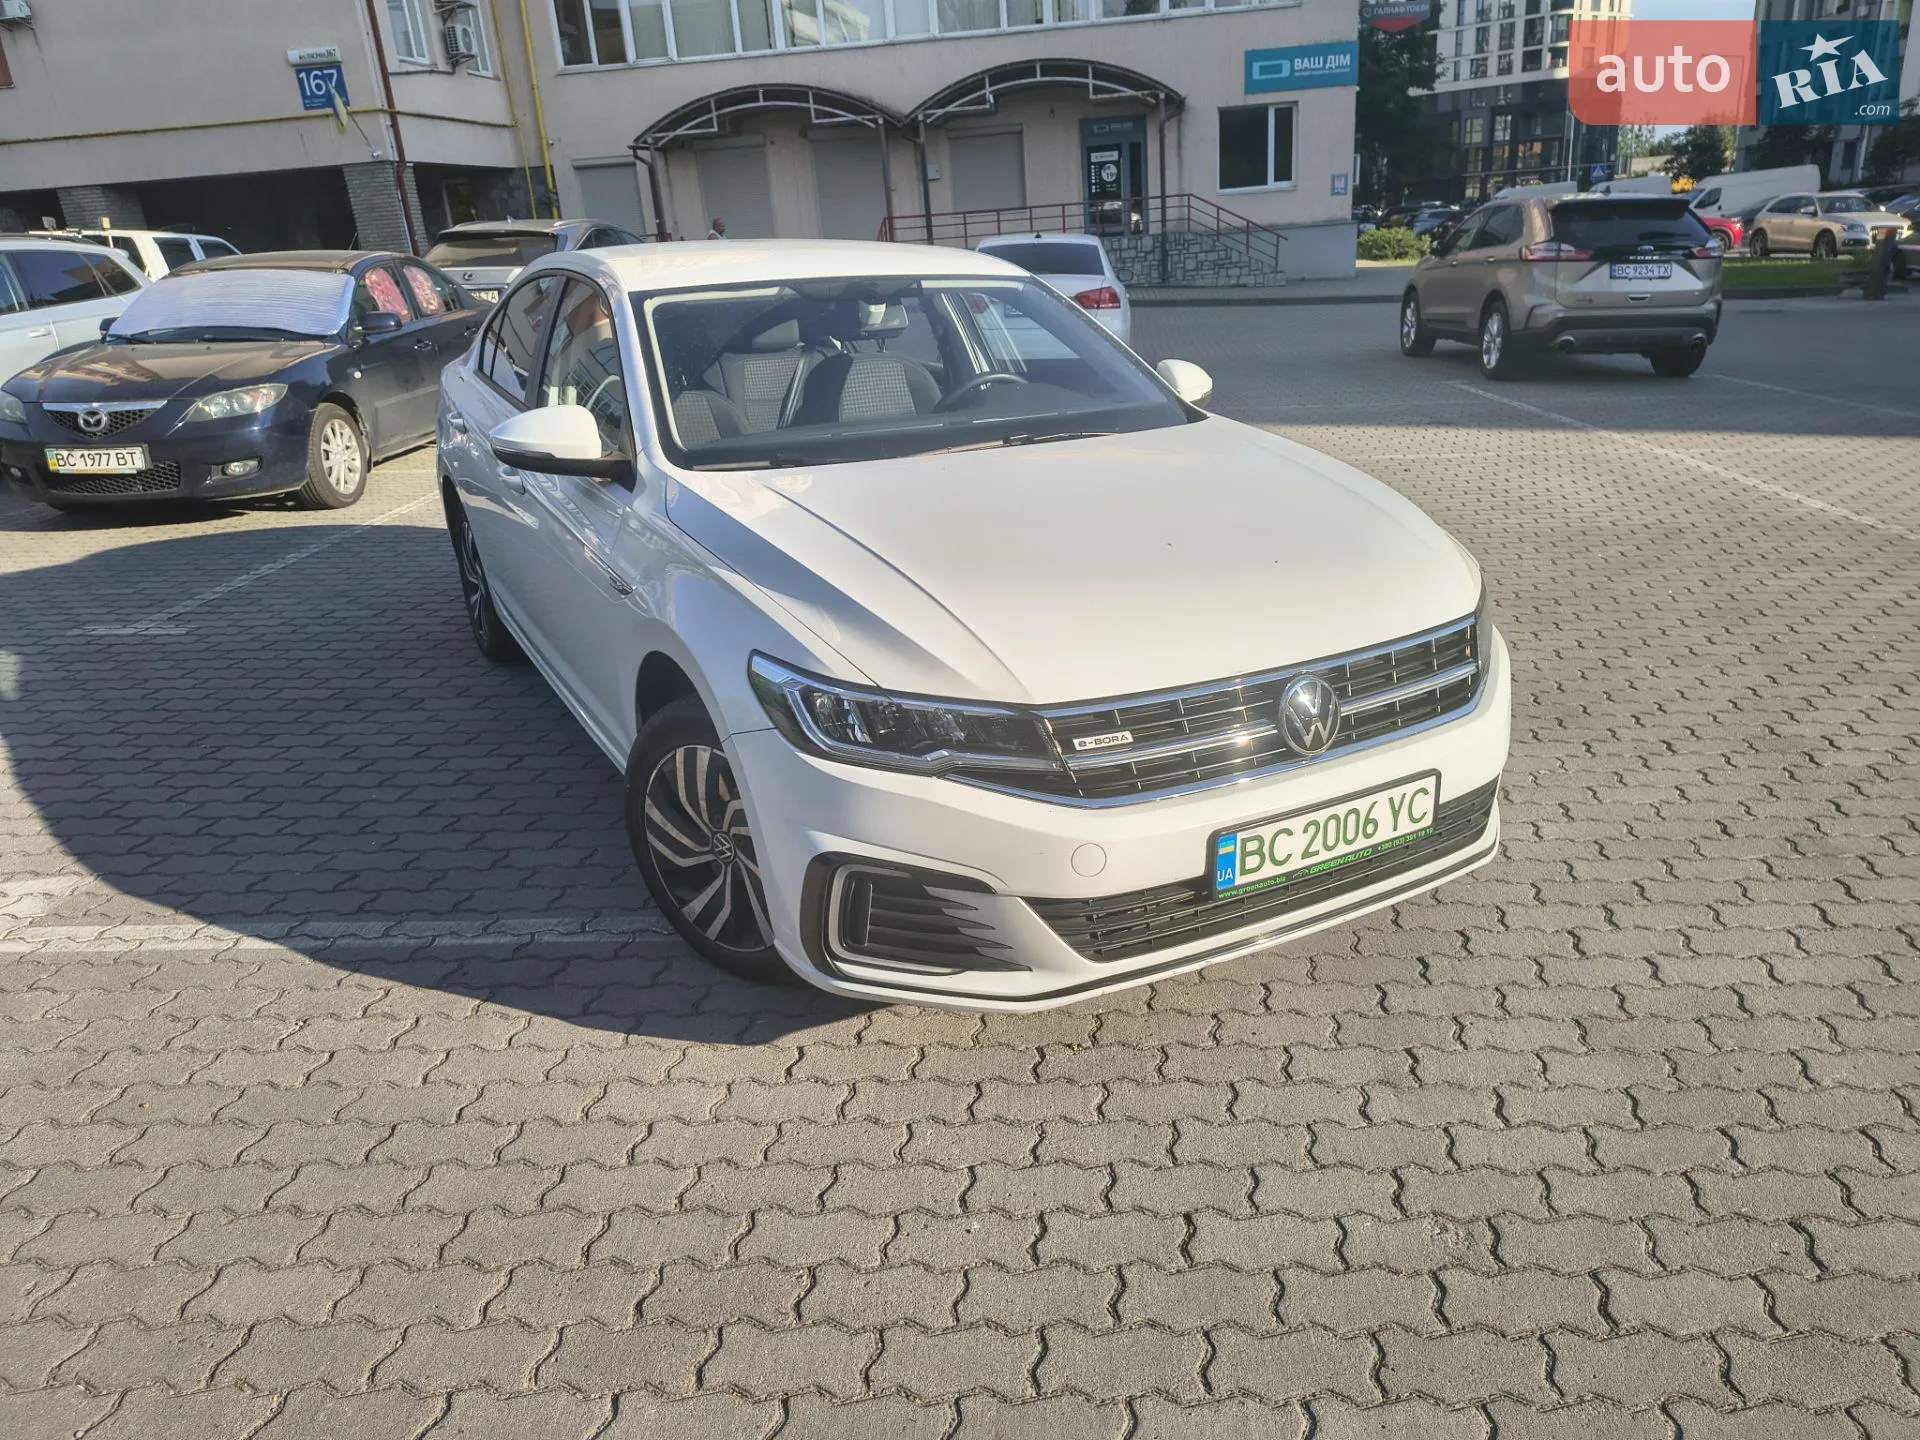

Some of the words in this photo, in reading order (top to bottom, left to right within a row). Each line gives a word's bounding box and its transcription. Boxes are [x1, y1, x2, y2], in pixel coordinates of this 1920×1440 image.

[1294, 56, 1323, 70] ВАШ
[1325, 53, 1351, 69] ДІМ
[299, 69, 337, 96] 167
[1616, 264, 1631, 276] BC
[1632, 263, 1655, 276] 9234
[55, 452, 77, 467] BC
[79, 452, 111, 467] 1977
[115, 451, 136, 466] BT
[1078, 734, 1128, 748] e-BORA
[1239, 828, 1293, 876] BC
[1301, 801, 1378, 860] 2006
[1388, 787, 1429, 832] YC
[1310, 848, 1373, 874] GREENAUTO
[1217, 868, 1233, 882] UA
[1218, 876, 1286, 898] www.greenauto.biz
